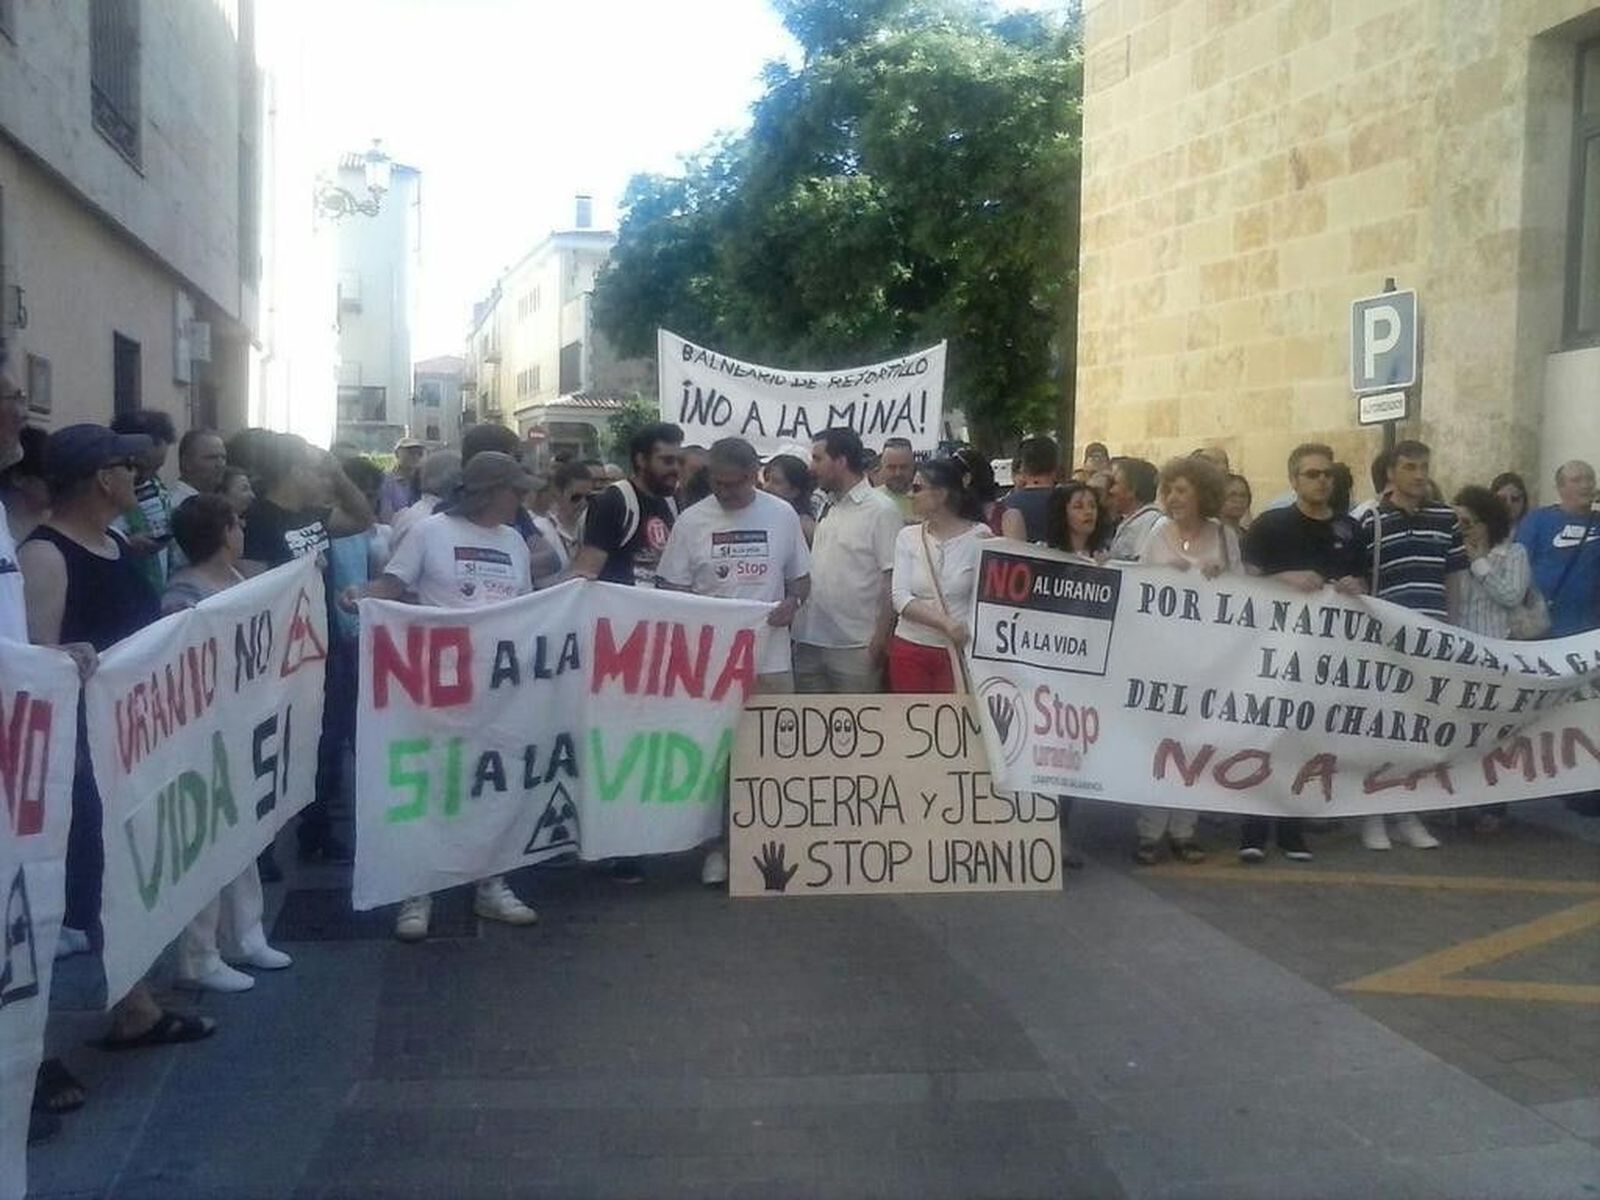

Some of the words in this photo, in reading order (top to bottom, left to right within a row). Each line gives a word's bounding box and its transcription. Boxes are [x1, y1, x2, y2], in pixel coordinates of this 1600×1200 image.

[681, 343, 788, 387] BALNEARIO
[790, 377, 818, 389] DE
[1364, 305, 1401, 379] P
[741, 400, 766, 437] A
[776, 404, 813, 438] LA
[826, 390, 928, 436] MINA!
[737, 561, 768, 576] Stop
[984, 561, 1031, 601] NO
[1034, 575, 1052, 595] AL
[1054, 578, 1112, 603] URANIO
[1137, 582, 1202, 622] POR
[1213, 591, 1257, 628] LA
[372, 624, 474, 710] NO
[490, 640, 520, 690] A
[534, 632, 581, 679] LA
[591, 617, 757, 702] MINA
[1021, 634, 1031, 650] A
[1033, 635, 1051, 653] LA
[1054, 636, 1088, 657] VIDA
[115, 636, 218, 774] URANIO
[234, 610, 273, 693] NO
[1258, 647, 1303, 683] LA
[1314, 653, 1415, 695] SALUD
[1425, 675, 1450, 705] Y
[1456, 680, 1502, 712] EL
[744, 706, 884, 759] TODOS
[1034, 684, 1099, 754] Stop
[1124, 678, 1188, 716] DEL
[1200, 686, 1316, 732] CAMPO
[1325, 703, 1456, 748] CHARRO
[385, 736, 463, 825] SI
[470, 750, 508, 799] A
[523, 732, 580, 790] LA
[1152, 738, 1273, 790] NO
[1291, 752, 1338, 803] A
[124, 731, 239, 913] VIDA
[252, 703, 292, 822] SI
[733, 774, 905, 828] JOSERRA
[806, 840, 914, 888] STOP
[928, 838, 1055, 885] URANIO
